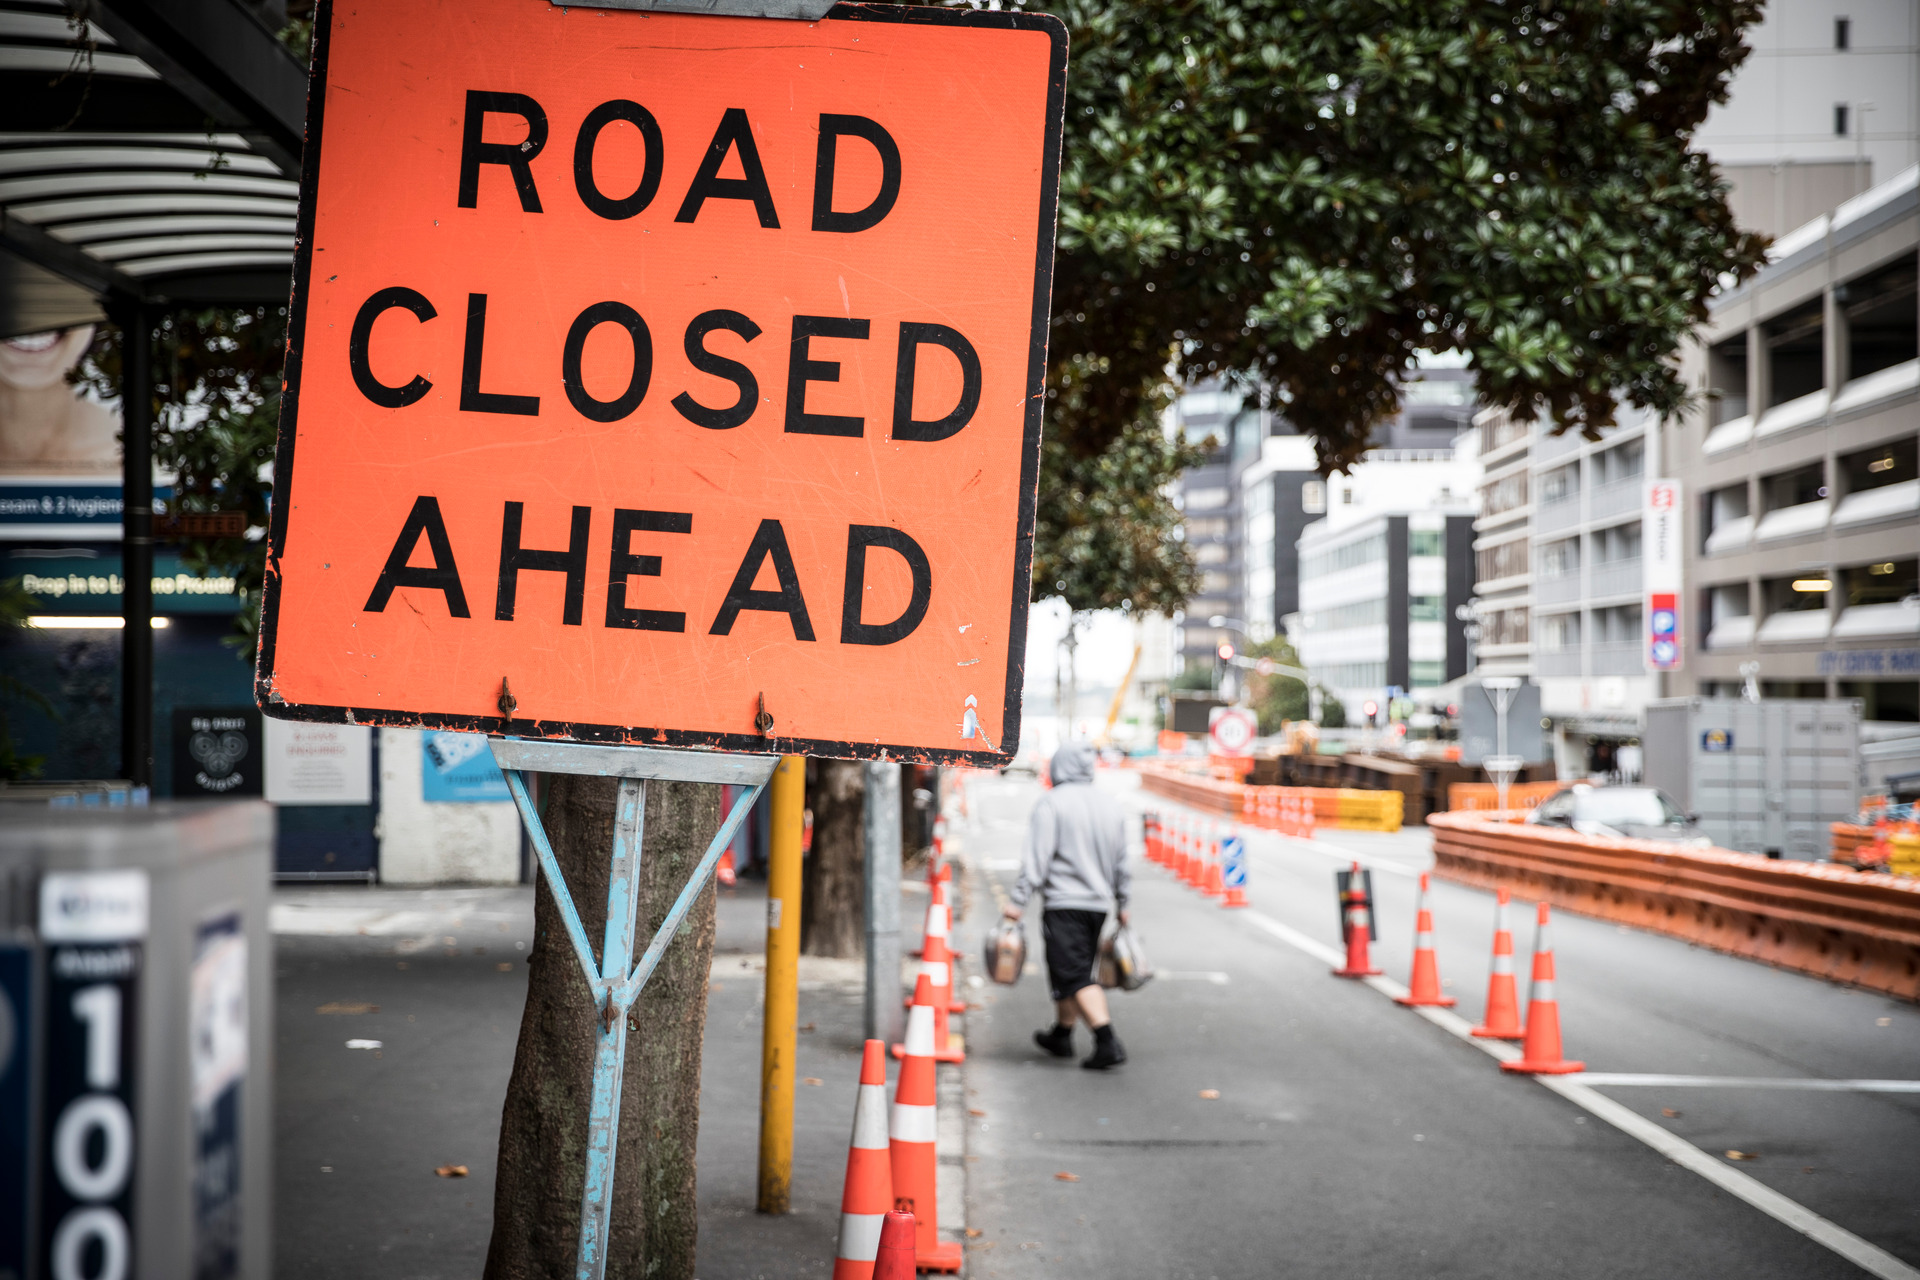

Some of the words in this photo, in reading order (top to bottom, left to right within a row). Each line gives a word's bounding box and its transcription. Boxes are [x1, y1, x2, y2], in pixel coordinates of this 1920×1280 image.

[458, 90, 901, 233] ROAD
[350, 287, 981, 442] CLOSED
[363, 496, 932, 645] AHEAD
